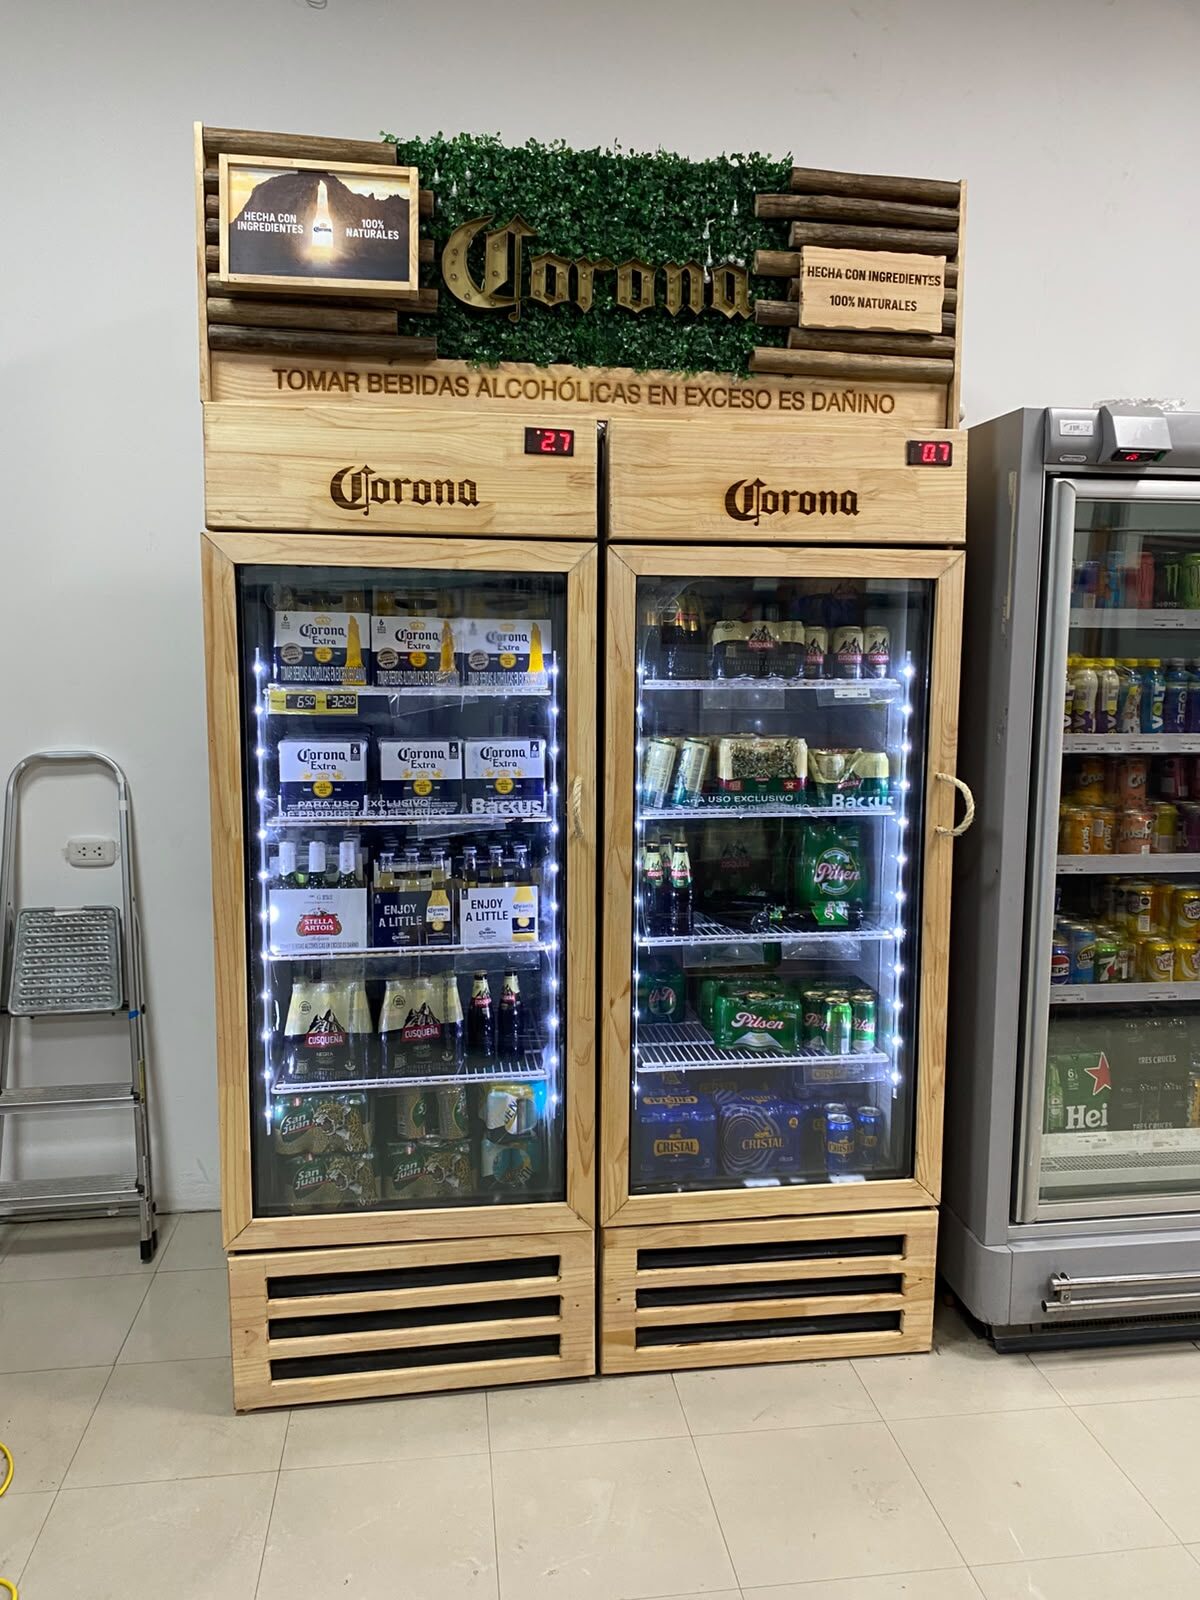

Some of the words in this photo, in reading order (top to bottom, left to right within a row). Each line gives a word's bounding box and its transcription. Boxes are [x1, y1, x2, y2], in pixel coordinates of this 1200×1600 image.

[244, 211, 275, 223] HECHA
[277, 213, 298, 224] CON
[237, 221, 304, 234] INGREDIENTES
[361, 219, 385, 231] 100%
[345, 227, 399, 240] NATURALES
[441, 213, 754, 323] Corona
[806, 265, 843, 279] HECHA
[844, 268, 867, 281] CON
[867, 271, 942, 286] INGREDIENTES
[829, 294, 856, 308] 100%
[856, 297, 918, 312] NATURALES
[272, 367, 360, 393] TOMAR
[367, 372, 469, 397] BEBIDAS
[475, 375, 641, 404] ALCOHÓLICAS
[647, 385, 678, 407] EN
[685, 386, 772, 410] EXCESO
[778, 391, 805, 411] ES
[811, 388, 896, 414] DAÑINO
[329, 464, 480, 516] Corona
[724, 477, 861, 527] Corona
[282, 614, 289, 622] 6
[299, 623, 347, 640] Corona
[395, 628, 441, 644] Corona
[486, 631, 529, 644] Corona
[312, 636, 337, 646] Extra
[407, 641, 431, 650] Extra
[497, 643, 520, 652] Extra
[1152, 682, 1166, 729] VOLT
[297, 748, 348, 765] Corona
[397, 747, 446, 763] Corona
[480, 746, 528, 762] Corona
[310, 761, 337, 771] Extra
[411, 759, 436, 769] Extra
[493, 758, 518, 768] Extra
[297, 800, 331, 808] PARA
[334, 800, 360, 808] USO
[708, 795, 731, 803] USO
[734, 794, 794, 803] EXCLUSIVO
[813, 862, 861, 883] Pilsen
[384, 903, 417, 915] ENJOY
[471, 898, 504, 910] ENJOY
[378, 918, 386, 928] A
[388, 915, 423, 927] LITTLE
[465, 912, 473, 922] A
[475, 910, 509, 922] LITTLE
[303, 924, 334, 932] ARTOIS
[731, 1011, 784, 1030] Pilsen
[404, 1024, 439, 1039] CUSQUEÑA
[307, 1033, 344, 1046] CUSQUEÑA
[1152, 1054, 1177, 1065] CRUCES
[285, 1112, 307, 1126] San
[281, 1119, 310, 1136] Juan
[656, 1140, 697, 1154] CRISTAL
[742, 1136, 785, 1151] CRISTAL
[398, 1160, 418, 1172] San
[297, 1167, 319, 1181] San
[394, 1167, 421, 1182] Juan
[294, 1174, 323, 1190] Juan
